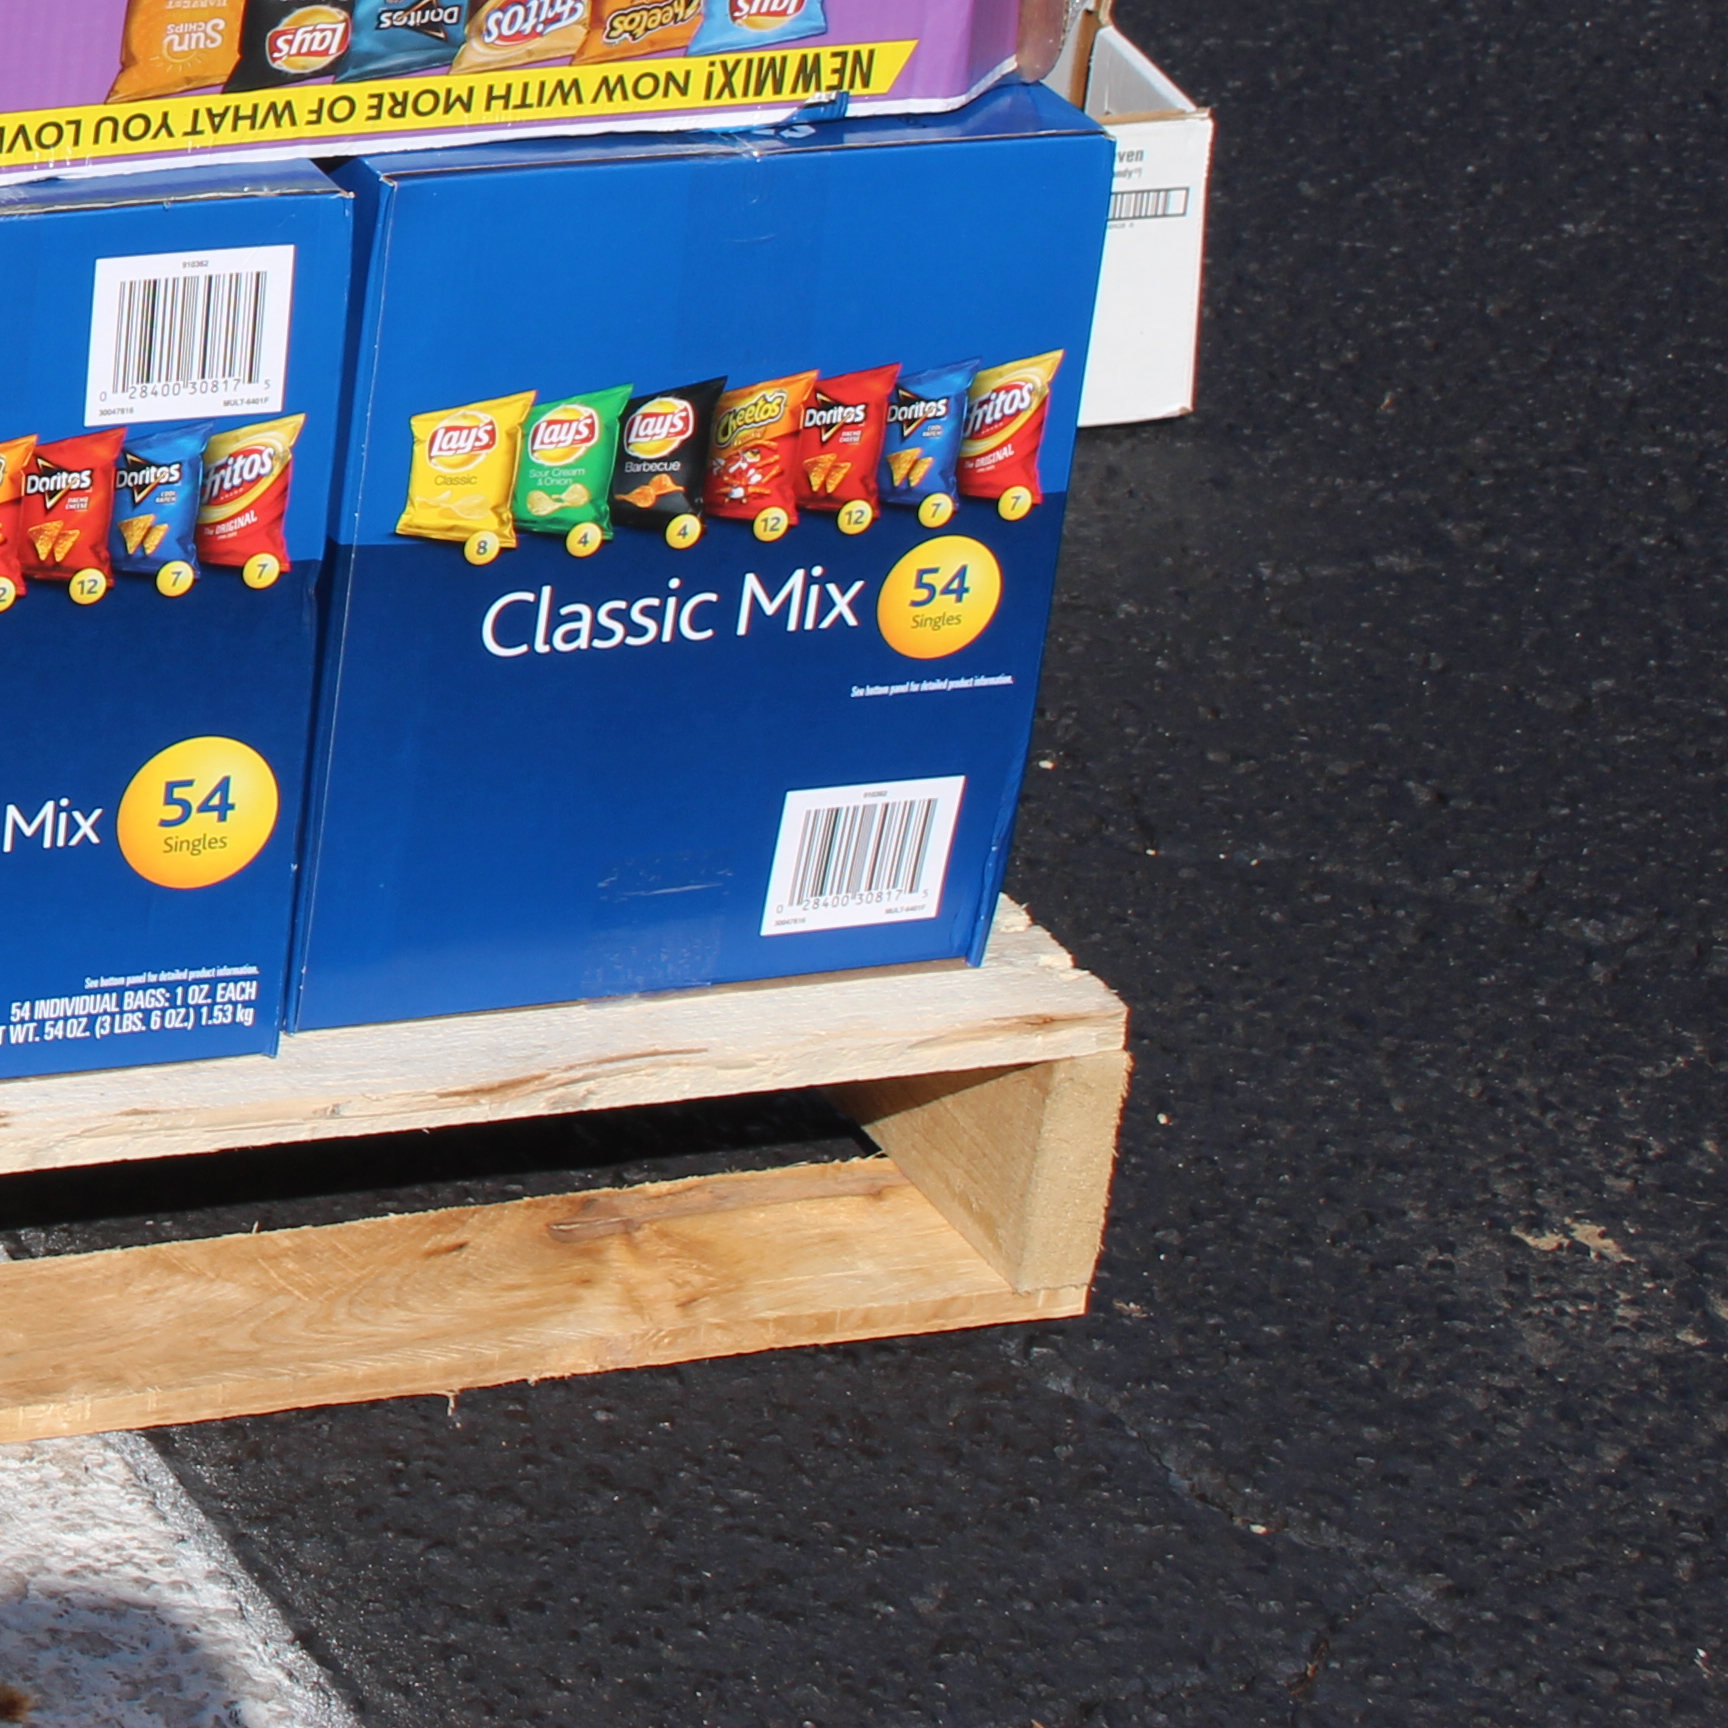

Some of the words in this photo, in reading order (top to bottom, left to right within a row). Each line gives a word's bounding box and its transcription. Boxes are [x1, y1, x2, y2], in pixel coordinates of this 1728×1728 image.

[379, 5, 460, 30] Doritos
[594, 68, 692, 107] NOW
[704, 55, 788, 100] MIX!
[790, 48, 875, 94] NEW
[308, 96, 358, 122] OF
[366, 83, 475, 119] MORE
[486, 78, 581, 110] WITH
[93, 114, 180, 144] YOU
[188, 100, 297, 135] WHAT
[127, 381, 182, 399] 28400
[188, 379, 242, 395] 30817
[804, 400, 866, 429] Doritos
[427, 421, 495, 458] Lay's
[26, 470, 92, 496] Doritos
[909, 565, 971, 607] 54
[482, 579, 718, 658] Classic
[736, 566, 864, 638] Mix
[911, 610, 962, 632] Singles
[158, 775, 236, 828] 54
[3, 799, 102, 854] Mix
[162, 831, 228, 856] Singles
